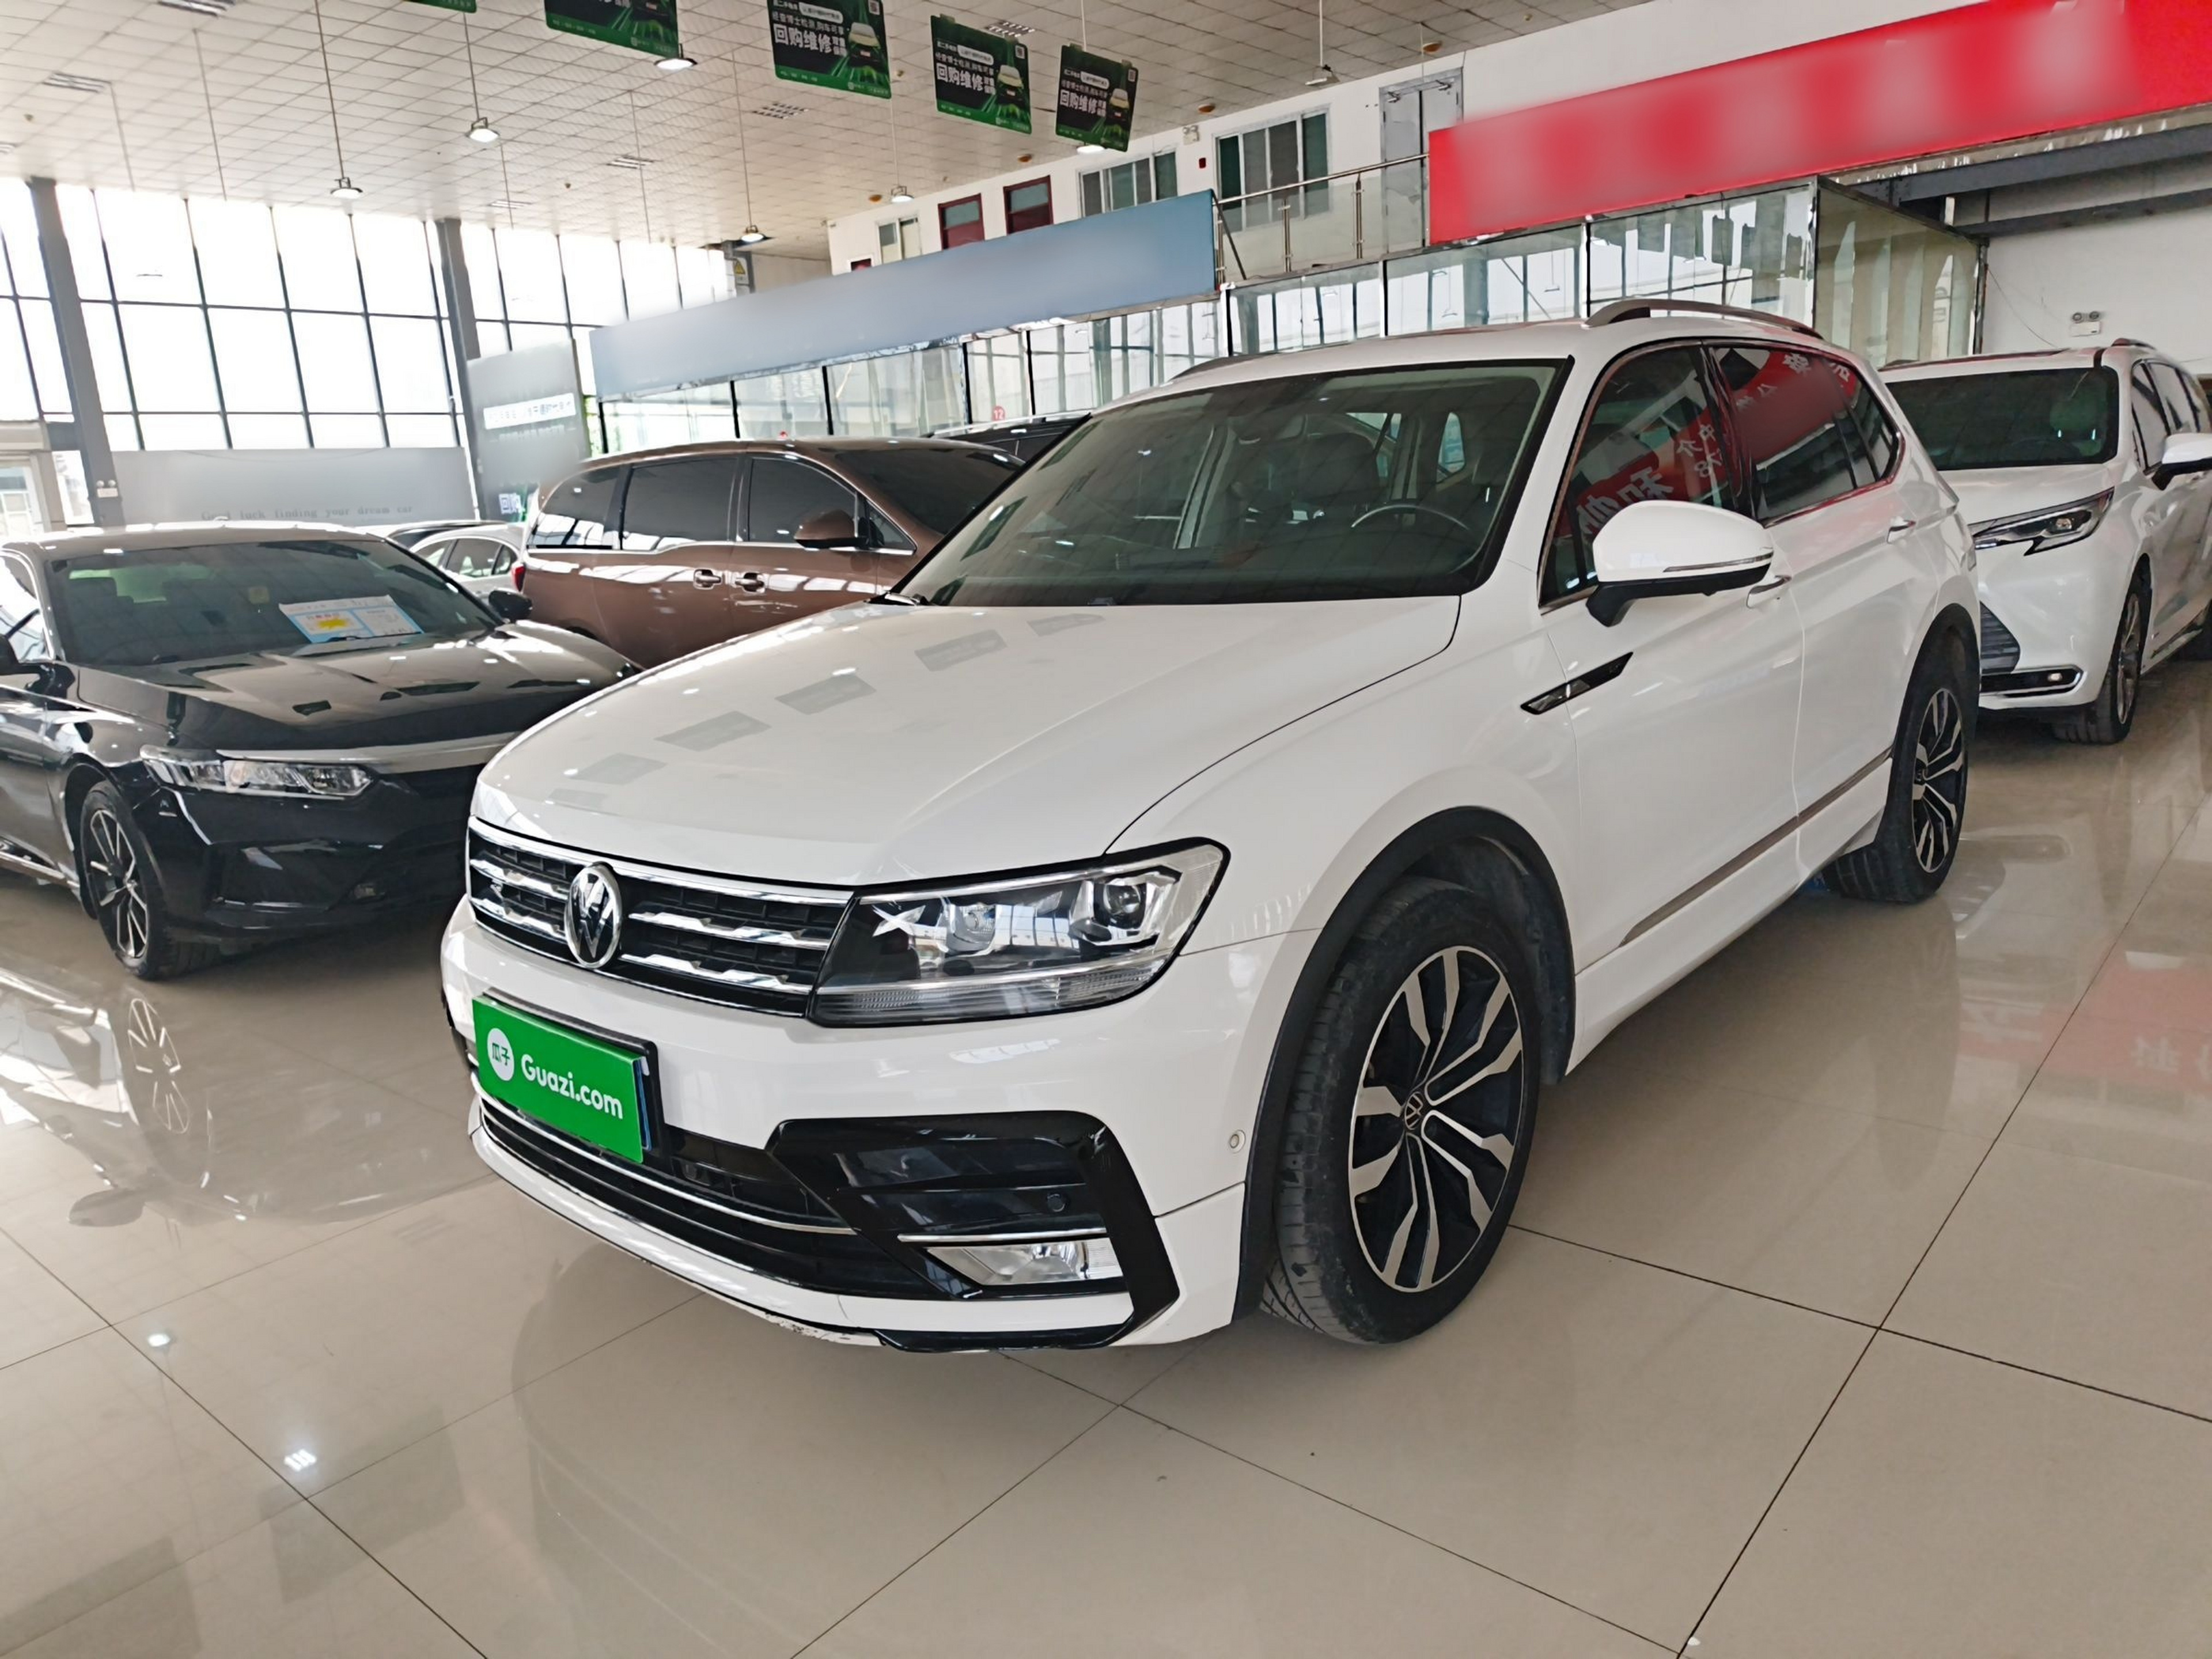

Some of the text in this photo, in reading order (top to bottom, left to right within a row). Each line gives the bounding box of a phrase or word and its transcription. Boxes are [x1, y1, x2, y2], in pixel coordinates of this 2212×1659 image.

[773, 23, 832, 53] 回购维修
[936, 63, 983, 91] 回购维修
[275, 508, 316, 518] finding
[325, 507, 349, 517] your
[358, 506, 389, 514] dream
[492, 1042, 510, 1066] 瓜子
[521, 1054, 623, 1119] Guazi.com
